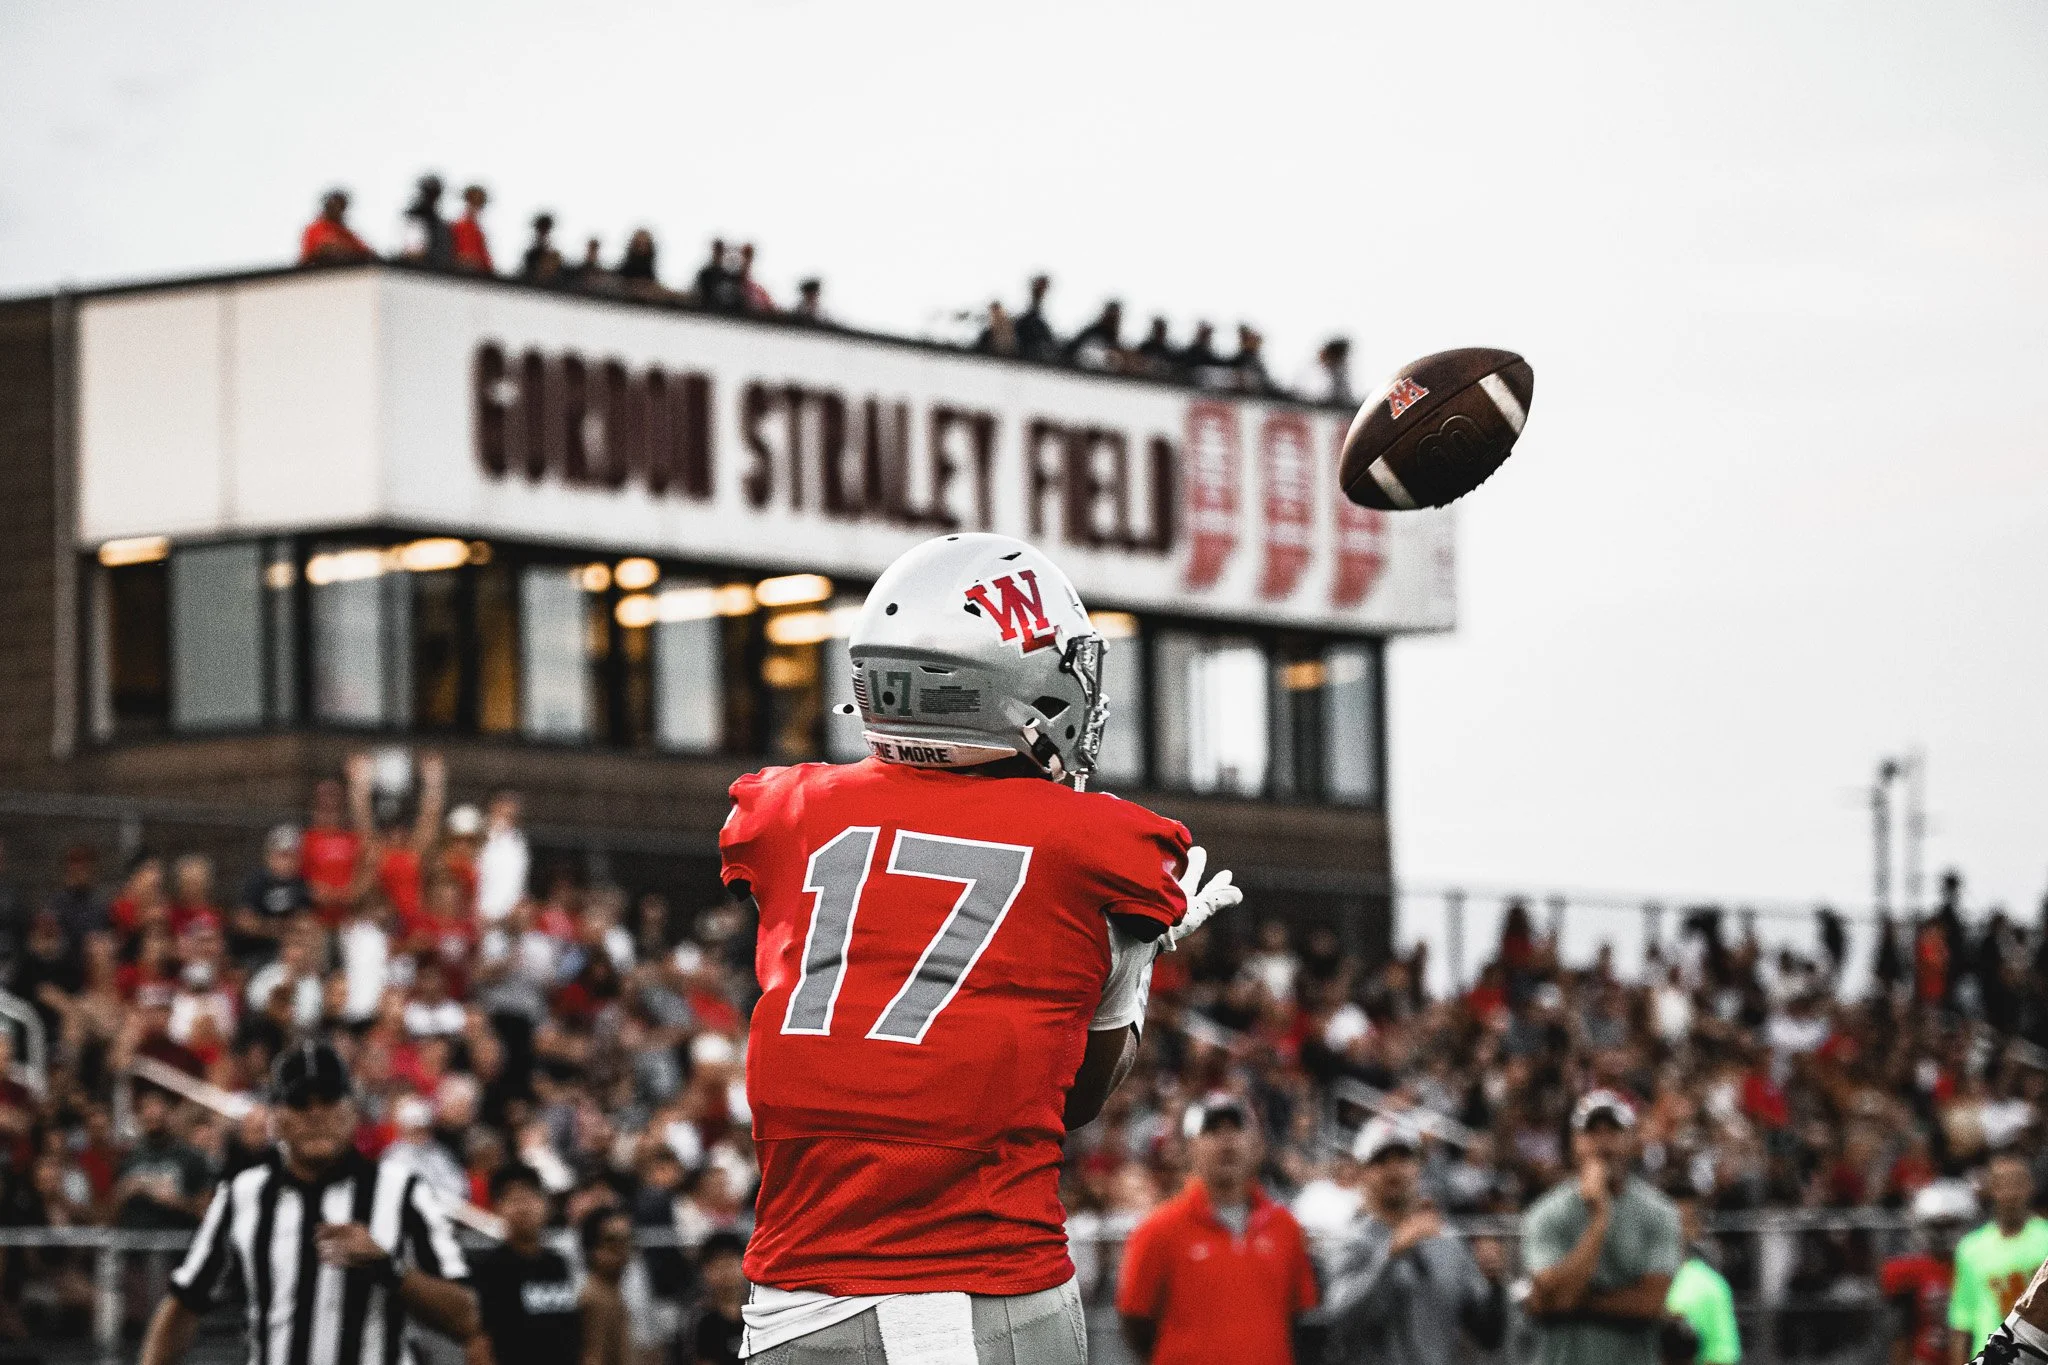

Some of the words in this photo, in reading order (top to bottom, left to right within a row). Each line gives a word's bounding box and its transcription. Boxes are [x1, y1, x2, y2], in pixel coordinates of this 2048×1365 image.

[1027, 415, 1180, 554] FIELD
[868, 669, 912, 717] 17
[870, 740, 895, 760] NE
[896, 744, 953, 764] MORE
[779, 825, 1034, 1045] 17
